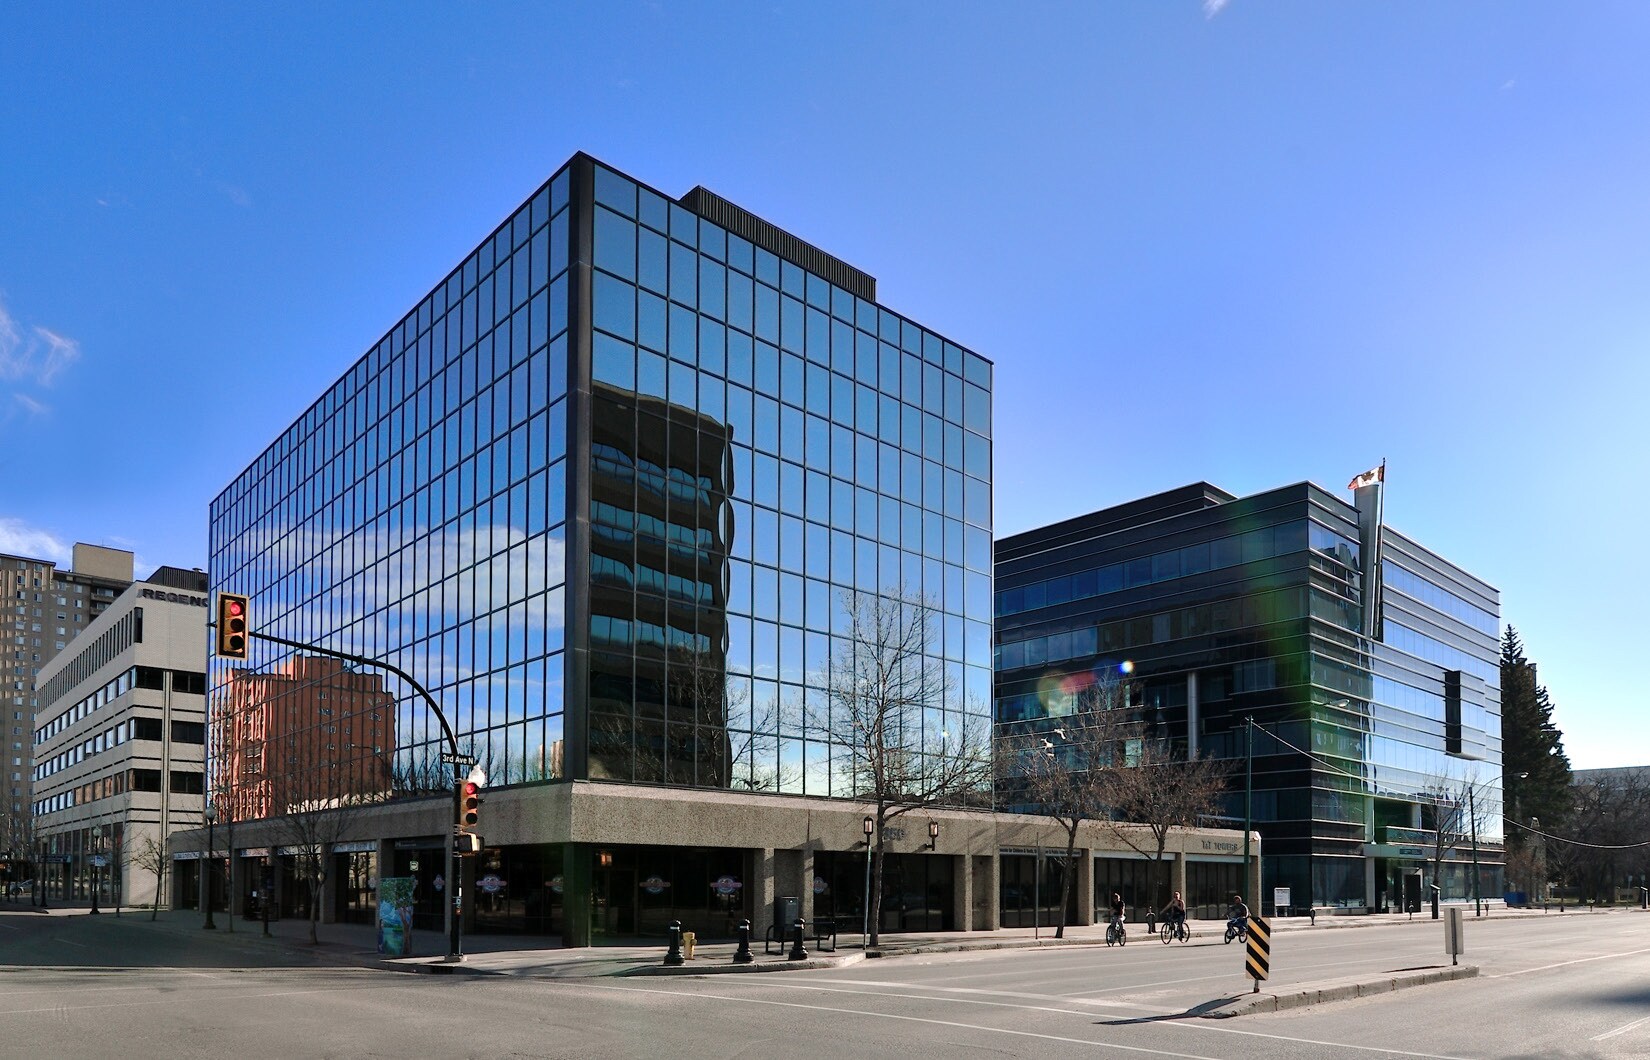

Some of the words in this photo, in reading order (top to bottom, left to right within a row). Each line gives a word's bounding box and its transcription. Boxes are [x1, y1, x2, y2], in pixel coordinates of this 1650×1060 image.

[442, 754, 454, 763] 3rd
[454, 755, 468, 765] Ave
[468, 757, 474, 765] N
